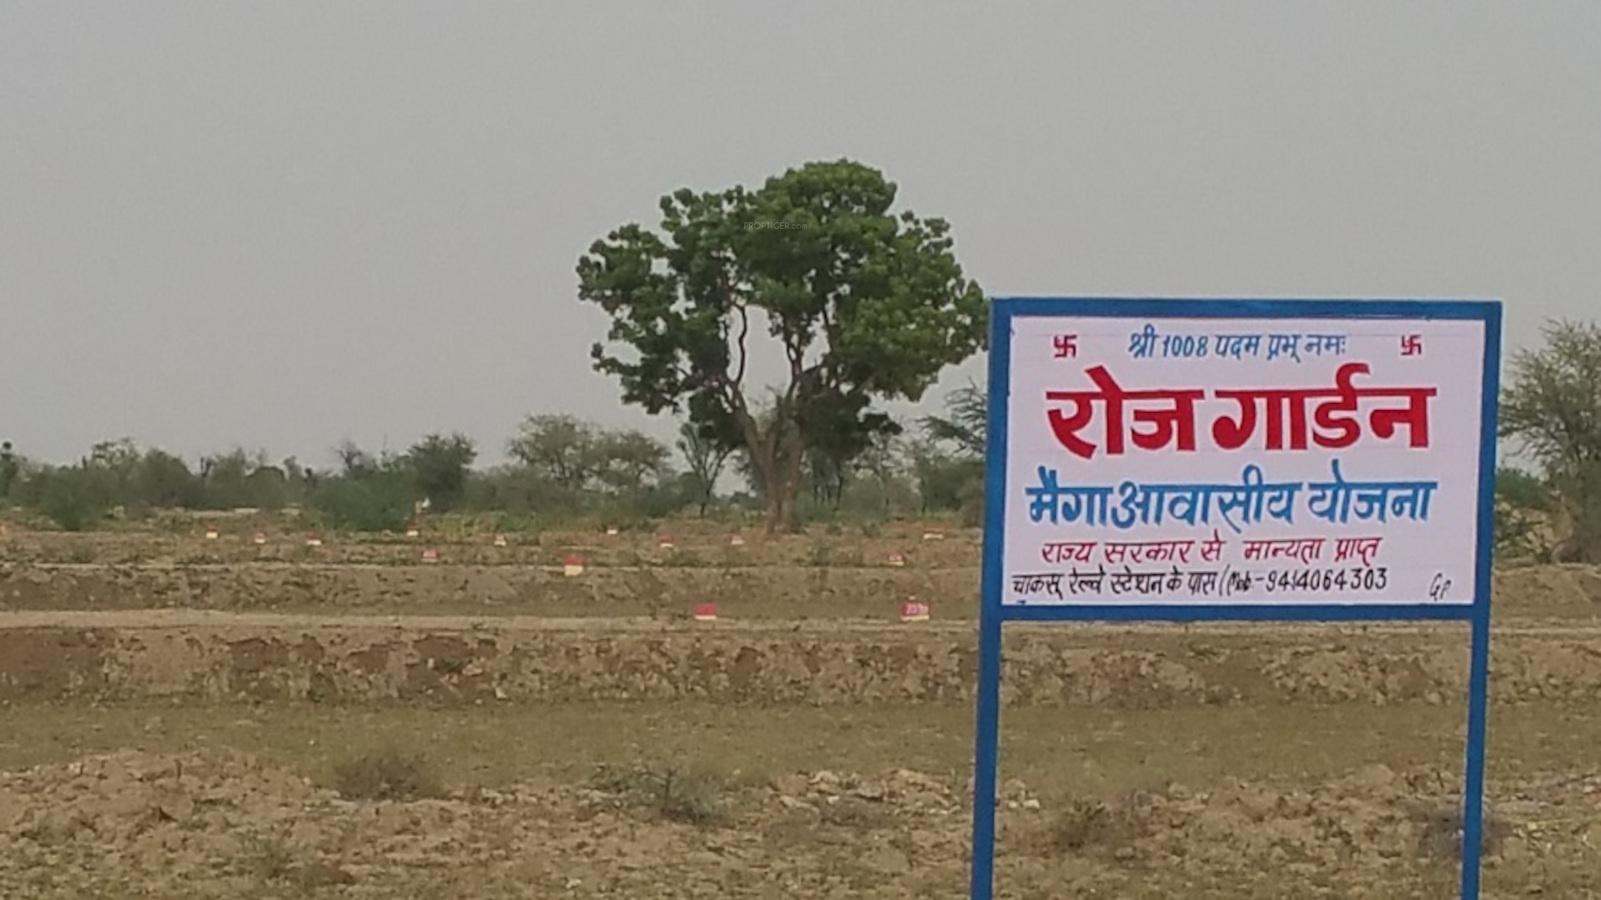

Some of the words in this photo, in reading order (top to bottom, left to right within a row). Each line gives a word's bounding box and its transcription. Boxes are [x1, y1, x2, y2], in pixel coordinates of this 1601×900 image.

[1128, 323, 1159, 358] श्री
[1163, 334, 1208, 357] 1008
[1215, 333, 1262, 359] पदम
[1304, 333, 1346, 355] नमः
[1046, 365, 1205, 460] रोज
[1211, 363, 1437, 451] गार्डन
[1308, 458, 1438, 524] योजना
[1042, 541, 1097, 563] राज्य
[1103, 540, 1195, 564] सरकार
[1200, 528, 1227, 561] से
[1243, 537, 1326, 565] मान्यता
[1333, 537, 1383, 566] प्राप्त
[1110, 565, 1165, 594] स्टेशन
[1166, 565, 1183, 591] के
[1187, 571, 1218, 595] पास
